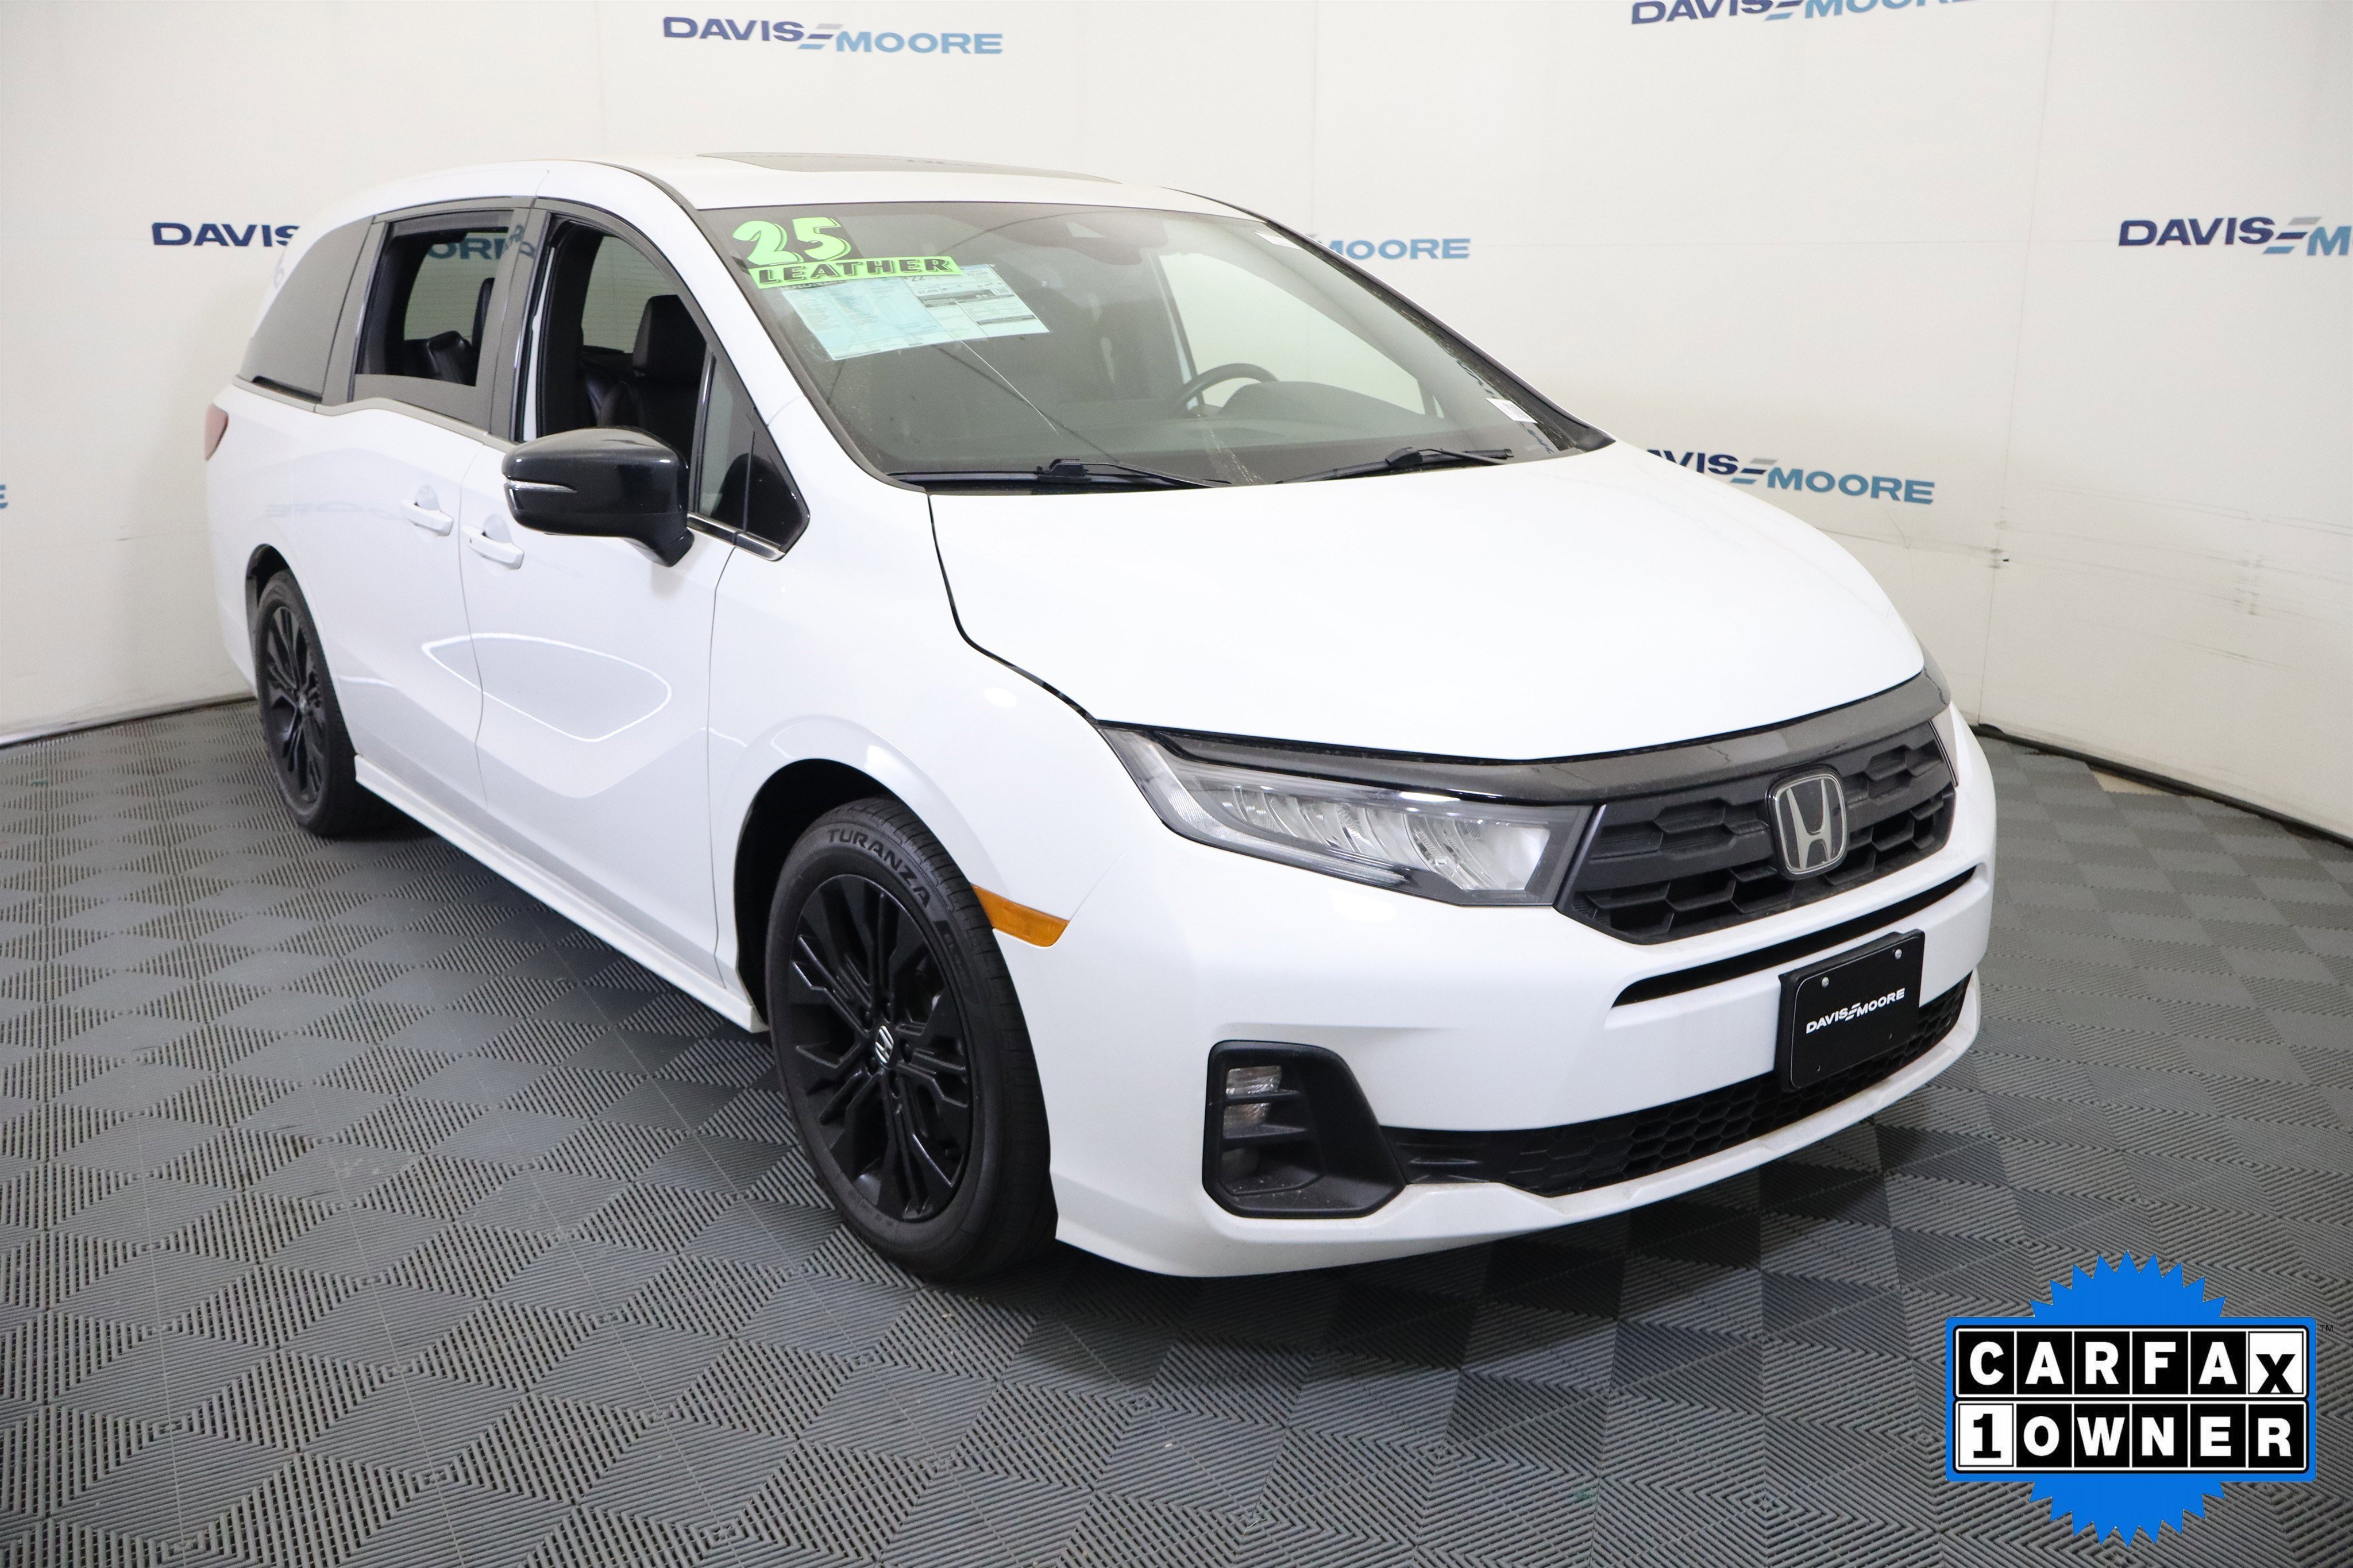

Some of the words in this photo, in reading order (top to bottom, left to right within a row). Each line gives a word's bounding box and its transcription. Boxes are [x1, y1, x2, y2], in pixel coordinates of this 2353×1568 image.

[1631, 0, 1773, 25] DAVIS
[664, 16, 804, 42] DAVIS
[836, 31, 1003, 55] MOORE
[151, 222, 300, 247] DAVIS
[732, 217, 851, 266] 25
[2118, 216, 2276, 246] DAVIS
[758, 258, 951, 284] LEATHER
[1767, 466, 1935, 505] MOORE
[827, 828, 931, 909] TURANZA
[1806, 1007, 1849, 1034] DAVIS
[1856, 987, 1906, 1017] MOORE
